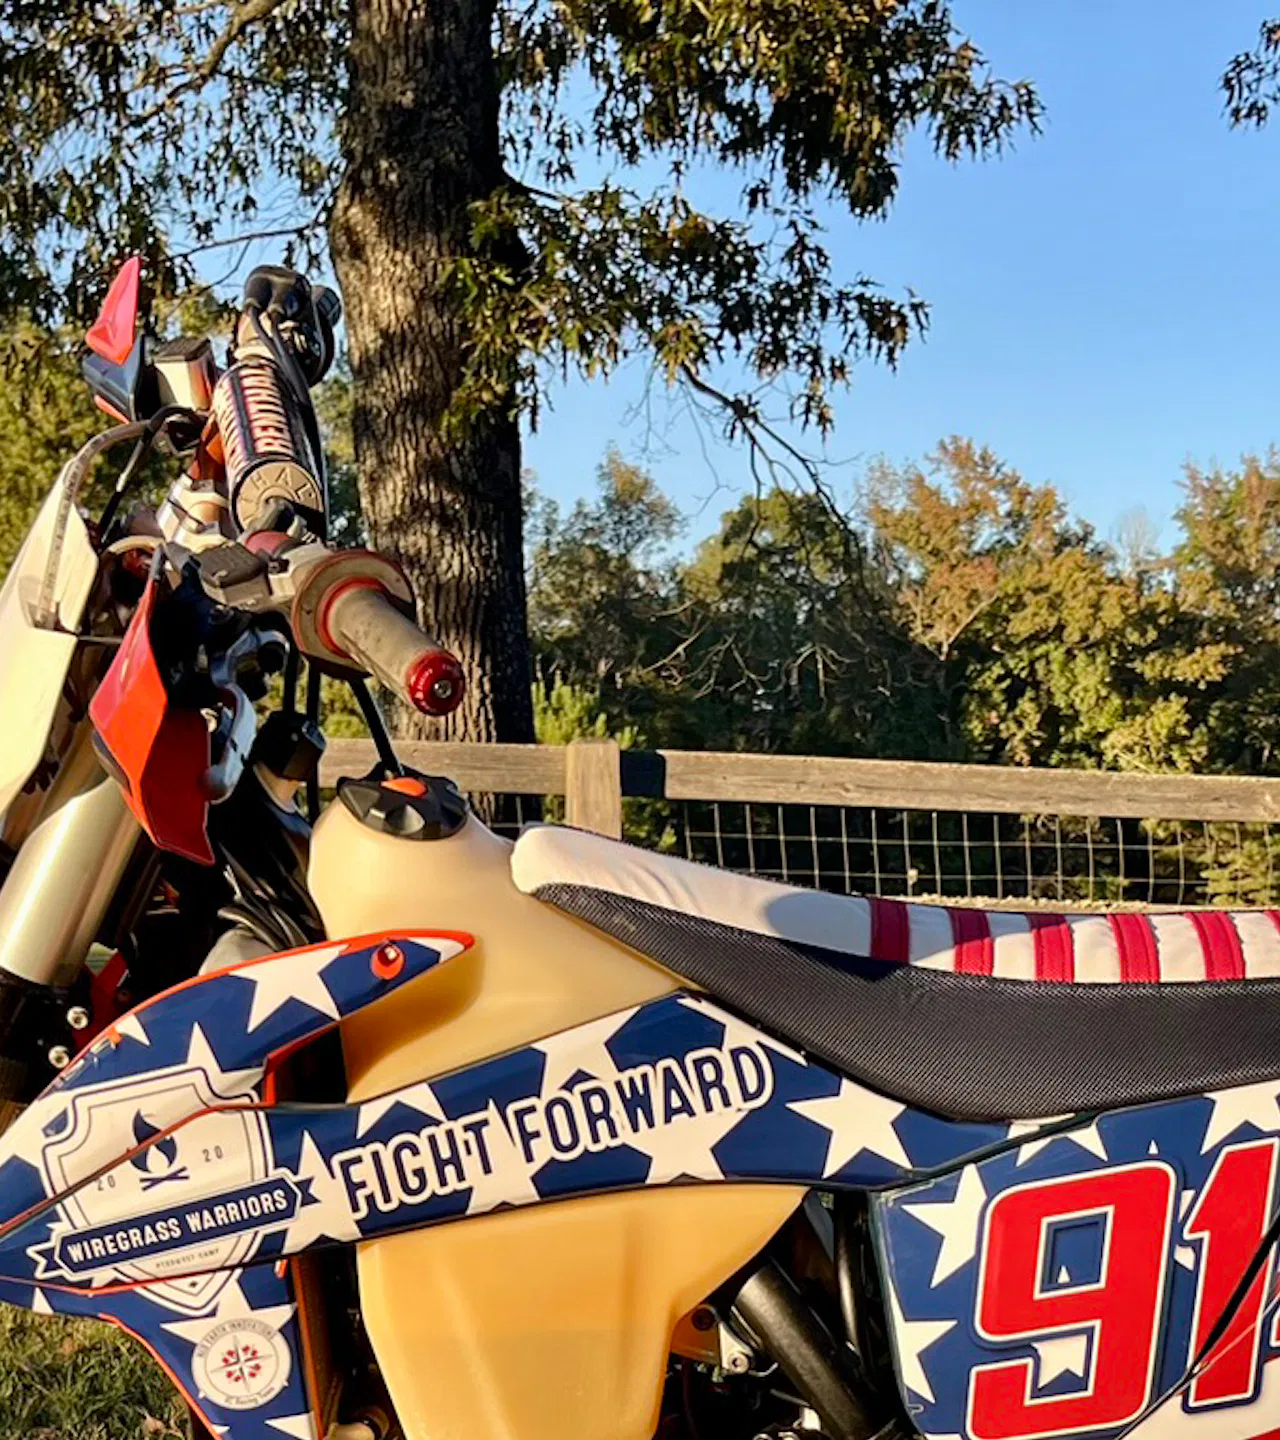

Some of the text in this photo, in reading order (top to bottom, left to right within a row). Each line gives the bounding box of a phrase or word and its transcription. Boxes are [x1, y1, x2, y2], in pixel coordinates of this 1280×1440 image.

[239, 366, 296, 457] RENTHAL
[203, 1145, 224, 1162] 20
[337, 1044, 775, 1218] FIGHT FORWARD
[67, 1189, 289, 1263] WIREGRASS WARRIORS
